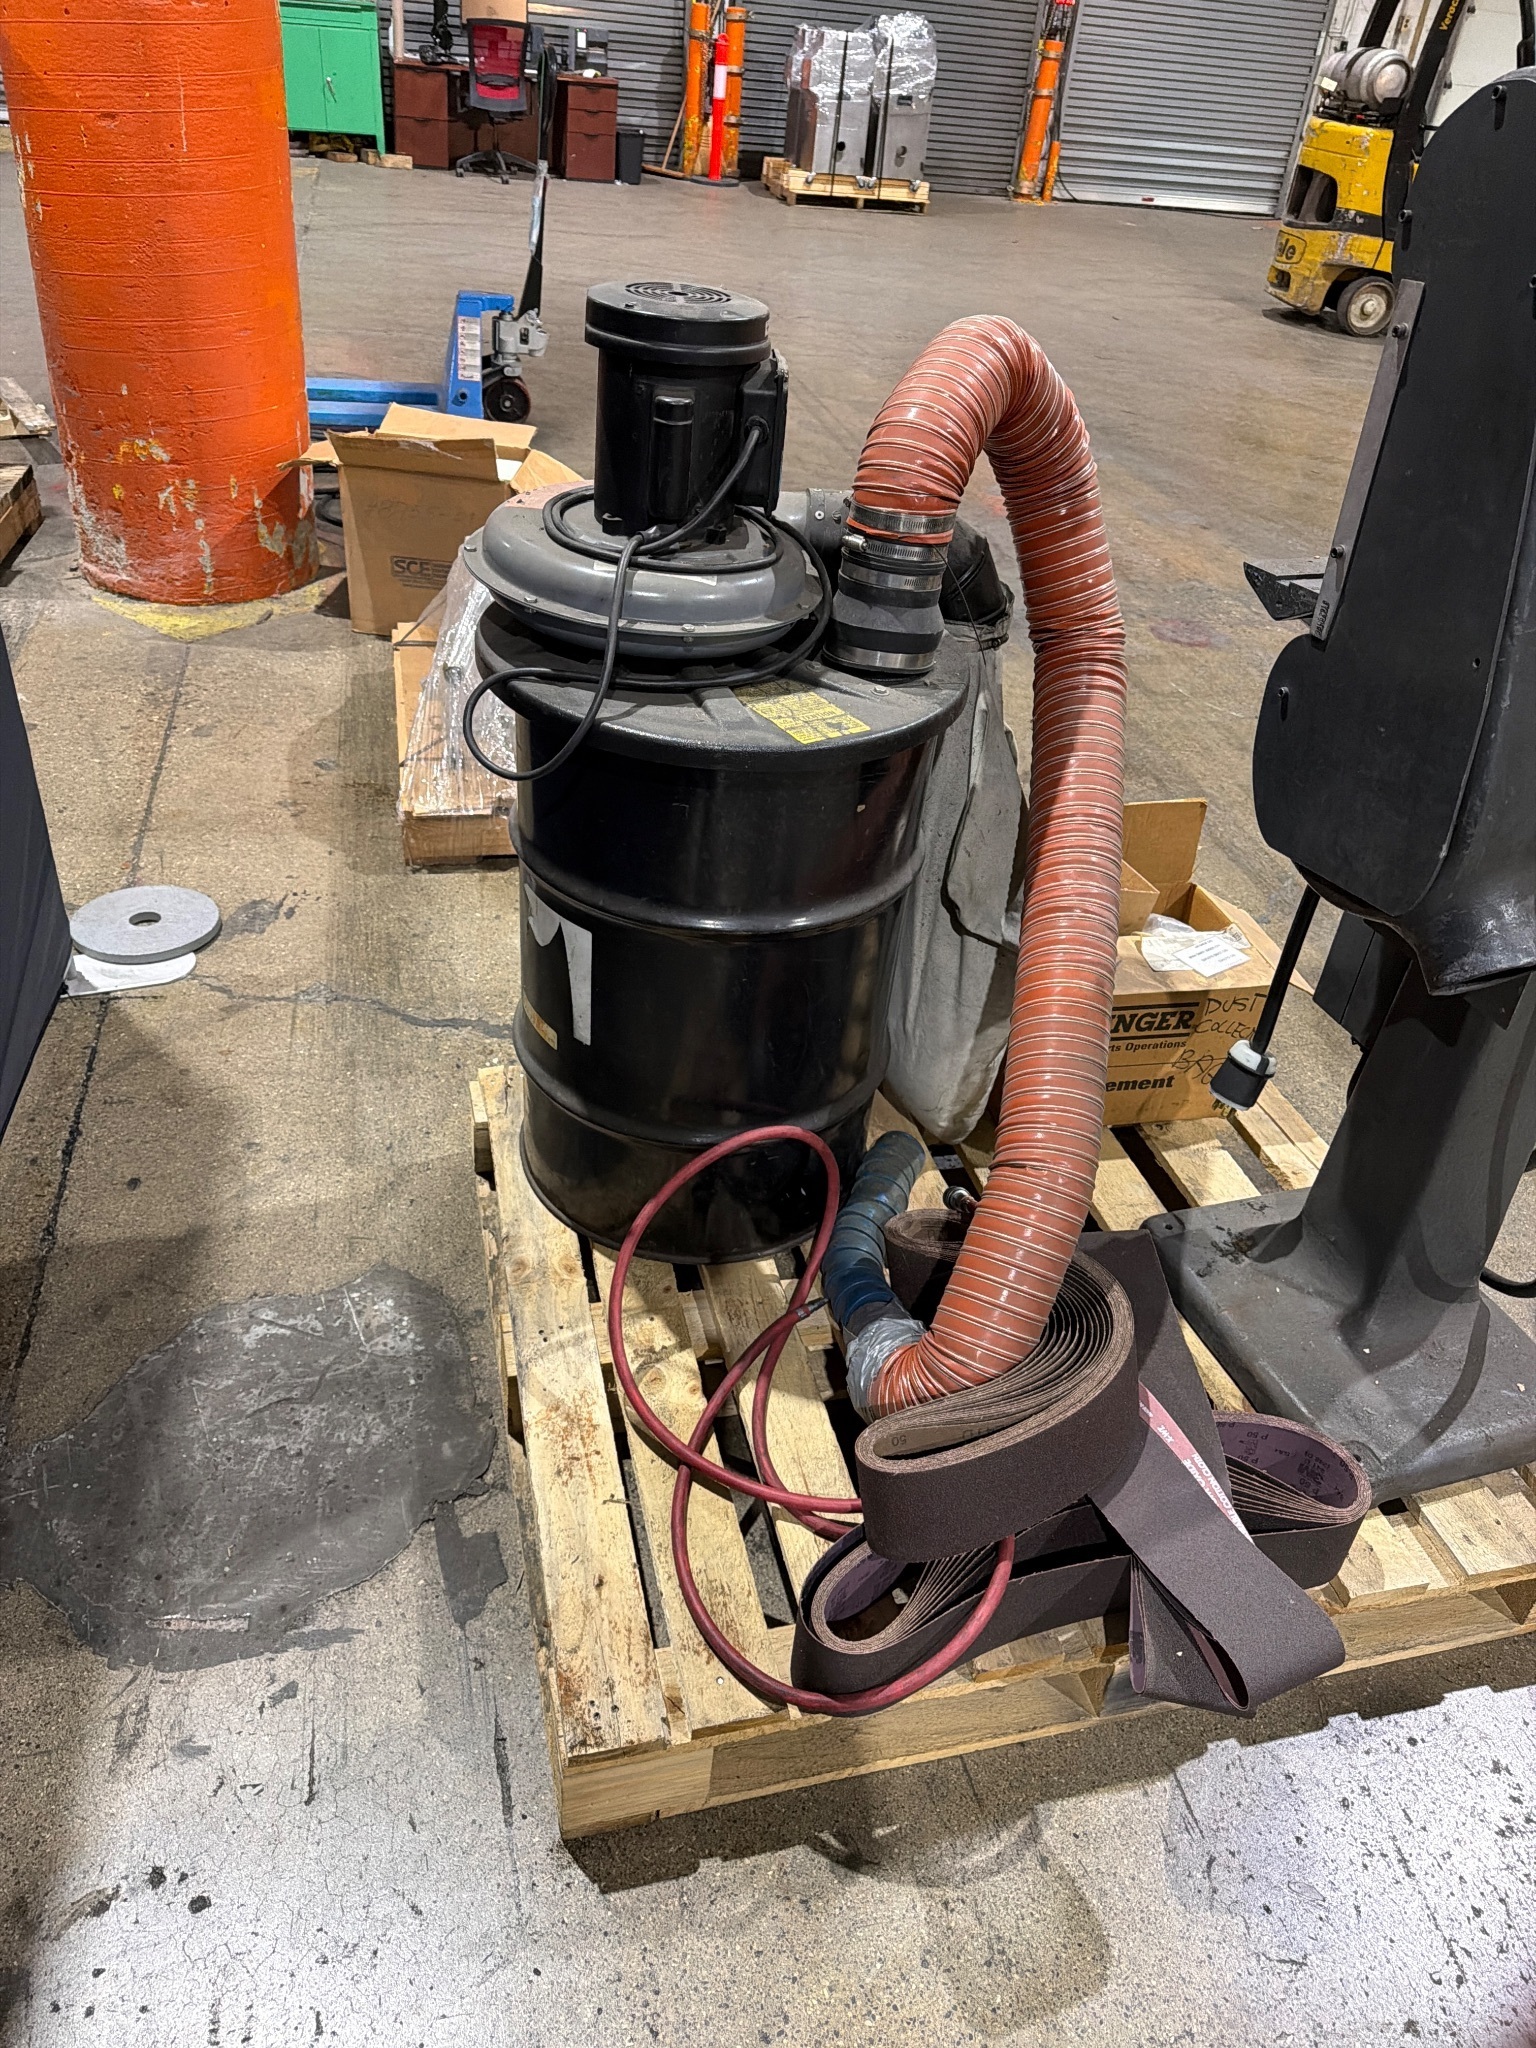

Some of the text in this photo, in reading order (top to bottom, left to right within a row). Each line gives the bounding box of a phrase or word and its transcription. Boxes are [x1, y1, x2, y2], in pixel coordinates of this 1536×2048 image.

[1204, 993, 1267, 1016] DUST
[1125, 1040, 1187, 1053] Operations
[1105, 1075, 1175, 1092] ement
[1192, 1453, 1210, 1477] CLOTH
[1208, 1476, 1232, 1509] COTTON
